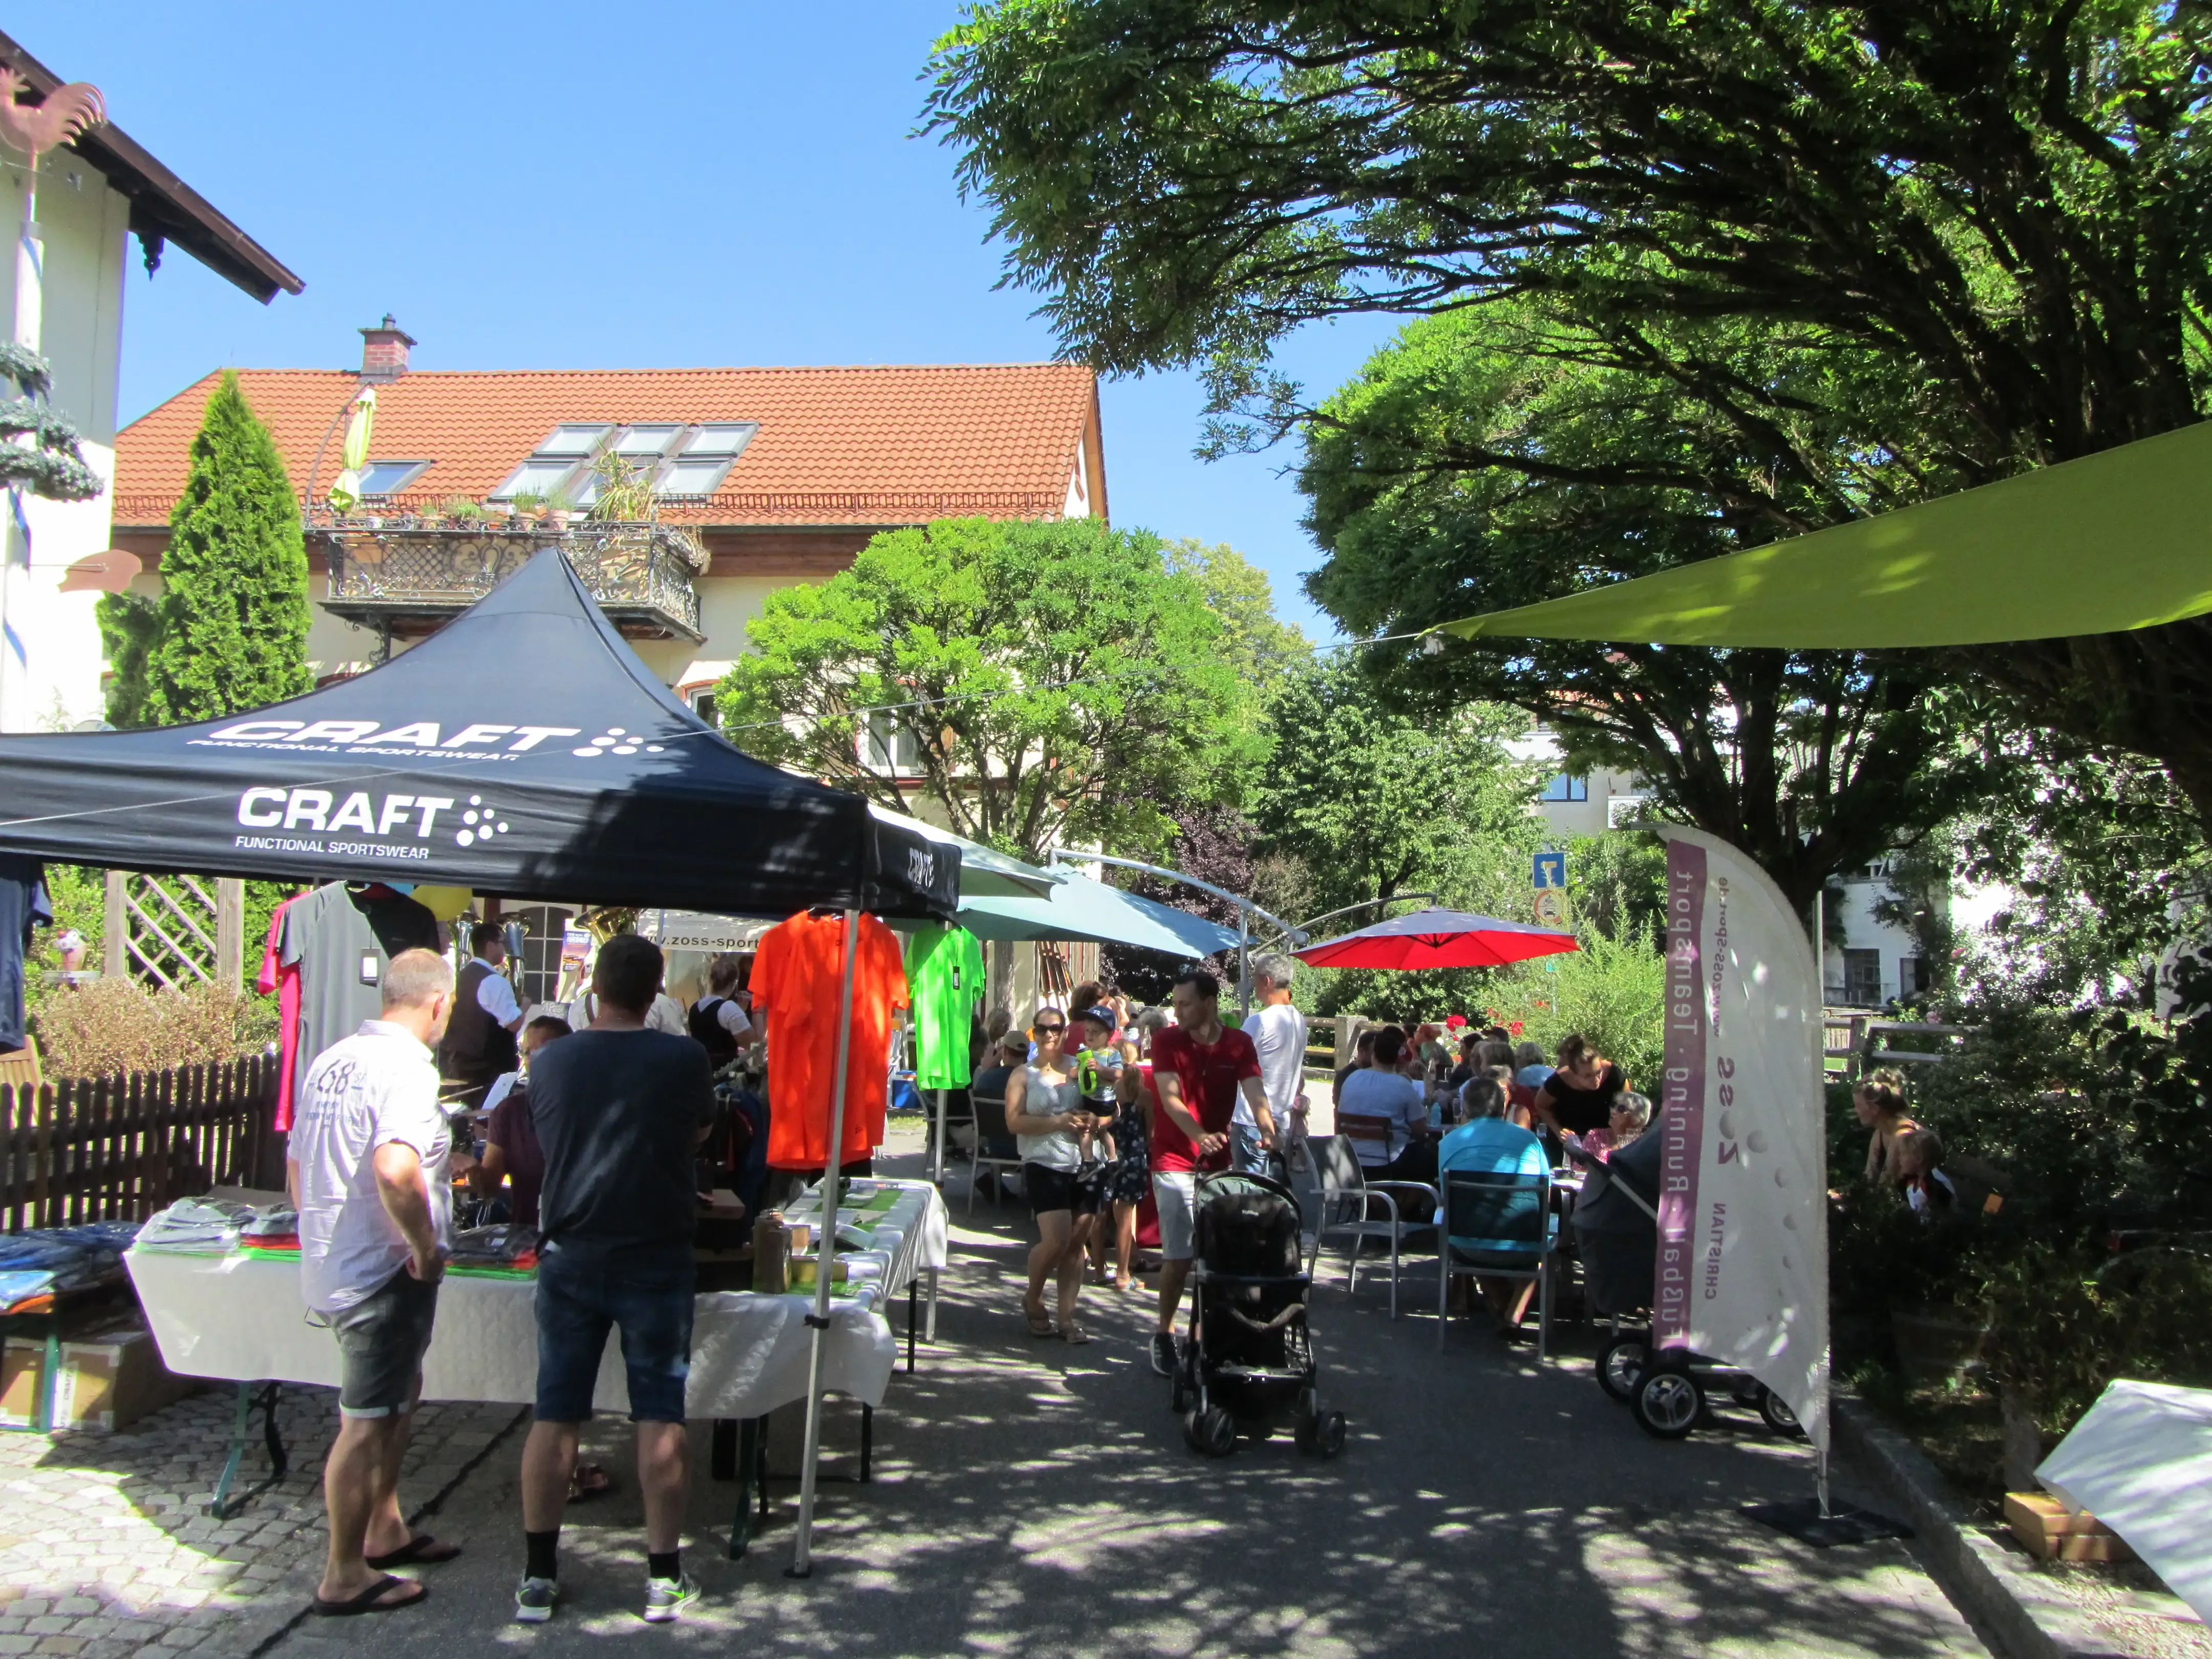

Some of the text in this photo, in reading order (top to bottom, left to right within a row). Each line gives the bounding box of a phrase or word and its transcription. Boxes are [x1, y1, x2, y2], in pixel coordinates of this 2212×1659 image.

[186, 740, 338, 752] FUNCTIONAL
[209, 721, 582, 751] CRAFT
[238, 787, 454, 838] CRAFT
[236, 836, 429, 859] FUNCTIONAL SPORTSWEAR
